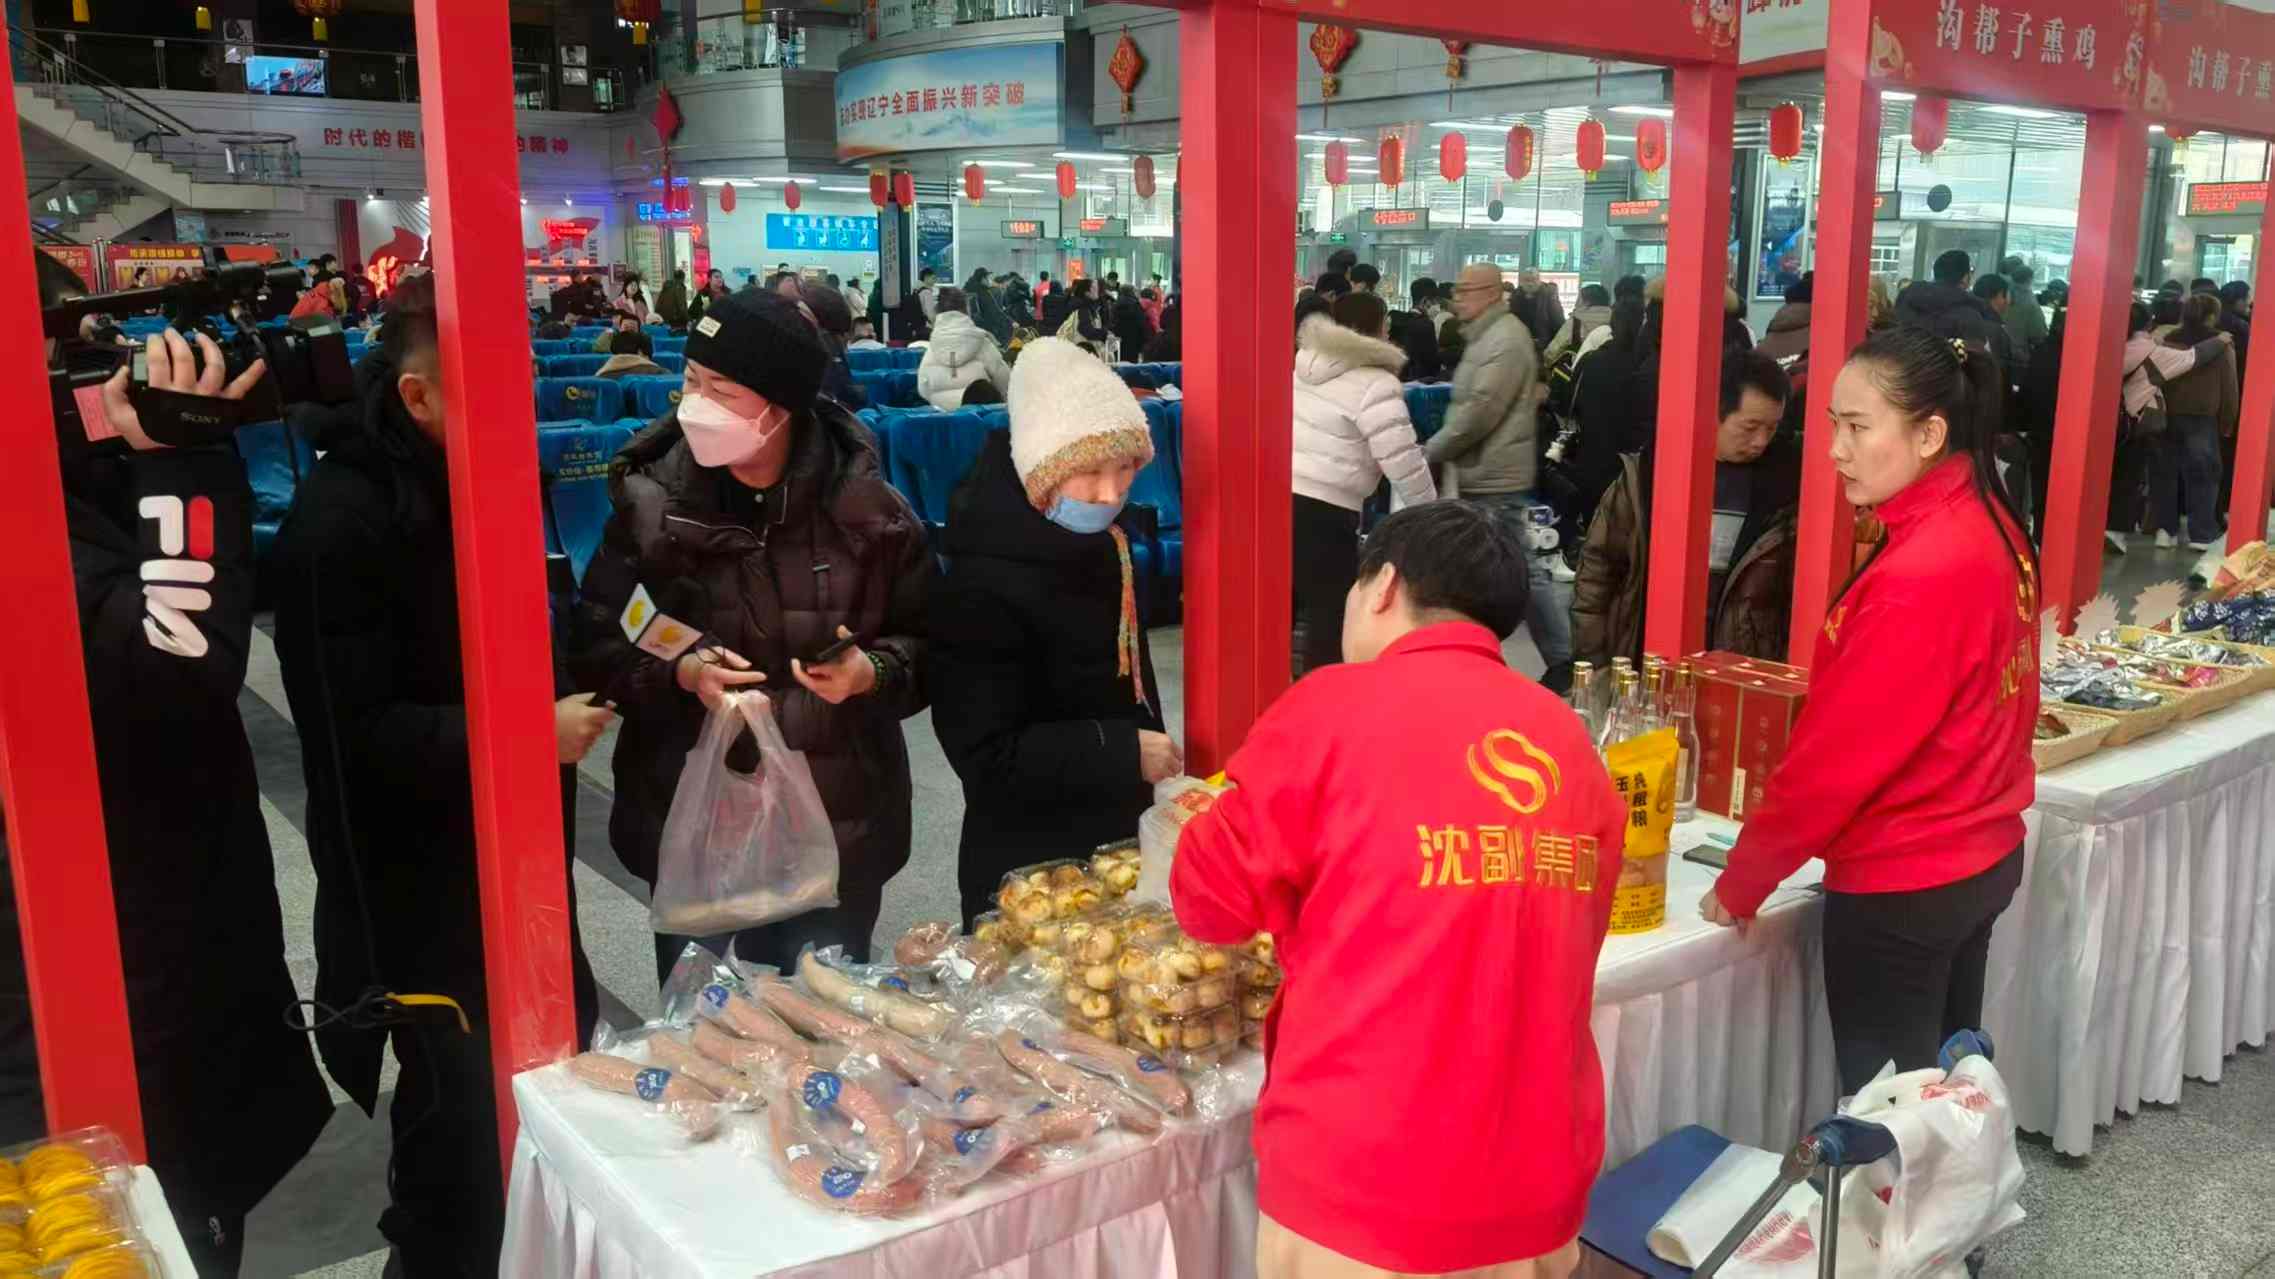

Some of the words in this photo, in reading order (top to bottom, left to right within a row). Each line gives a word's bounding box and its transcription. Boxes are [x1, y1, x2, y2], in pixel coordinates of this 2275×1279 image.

[1937, 0, 2097, 71] 沟帮子熏鸡
[323, 127, 425, 149] 时代的楷
[138, 495, 215, 658] FILA
